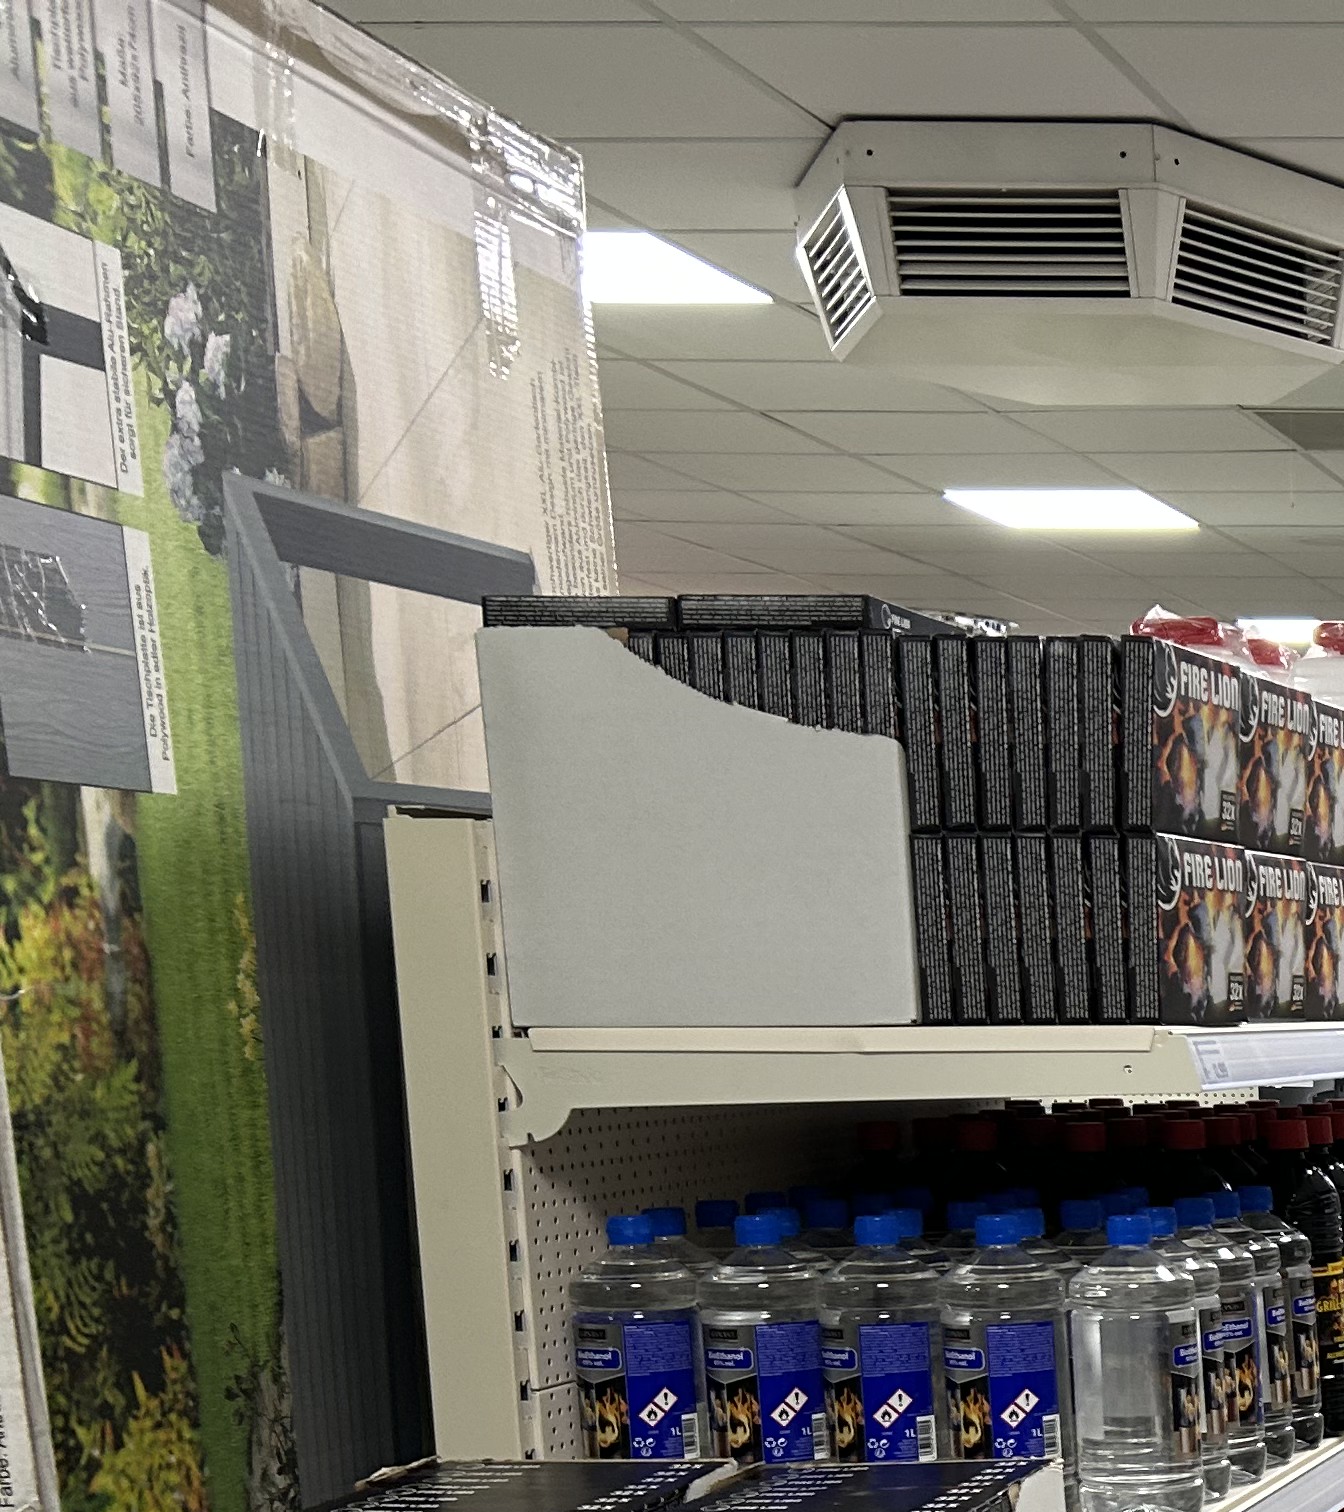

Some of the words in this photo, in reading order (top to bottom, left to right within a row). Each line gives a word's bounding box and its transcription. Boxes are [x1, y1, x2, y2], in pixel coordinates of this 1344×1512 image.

[1180, 661, 1209, 702] FIRE
[1211, 669, 1240, 711] LION
[1261, 690, 1285, 728] FIRE
[1287, 697, 1310, 735] LION
[1319, 711, 1340, 747] FIRE
[1183, 852, 1213, 889] FIRE
[1215, 858, 1243, 892] LION
[1259, 865, 1282, 897] FIRE
[1284, 869, 1306, 900] LION
